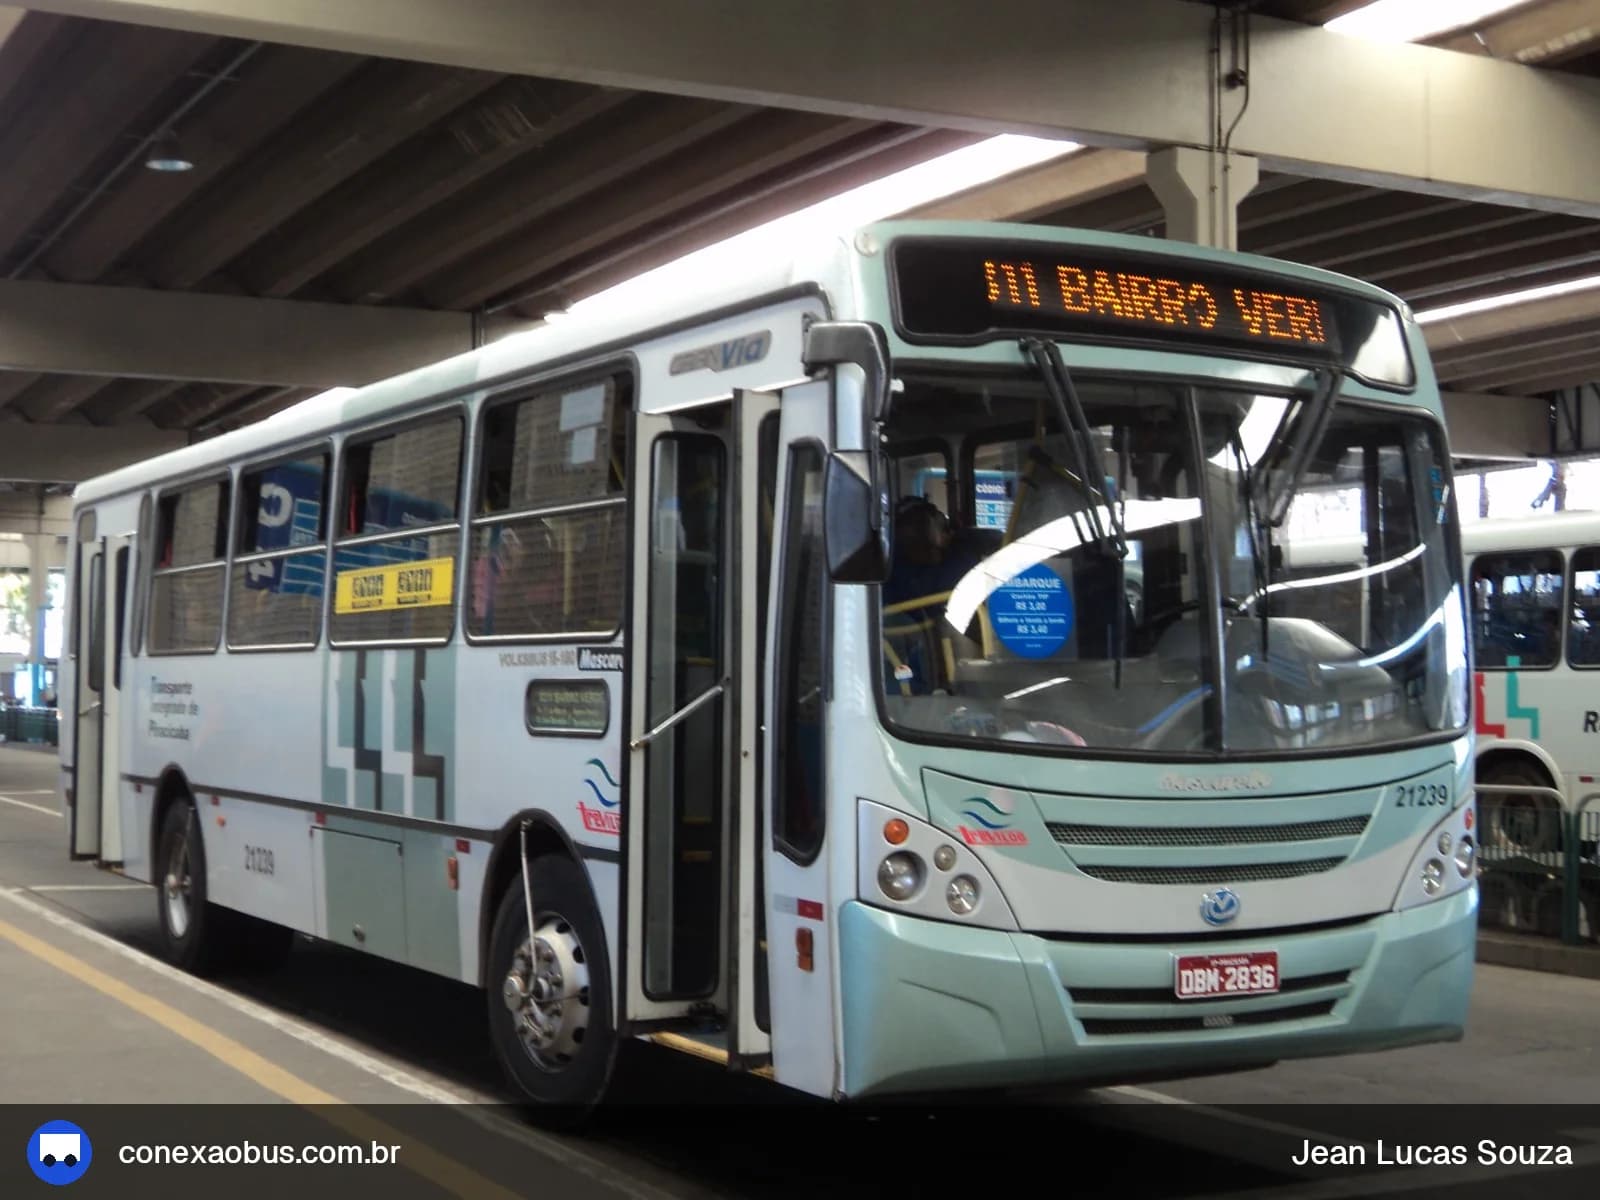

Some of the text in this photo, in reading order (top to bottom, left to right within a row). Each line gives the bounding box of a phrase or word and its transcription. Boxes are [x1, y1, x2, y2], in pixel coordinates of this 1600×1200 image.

[1057, 264, 1218, 328] BAIRRO
[1395, 784, 1448, 807] 21239
[244, 844, 275, 875] 21239
